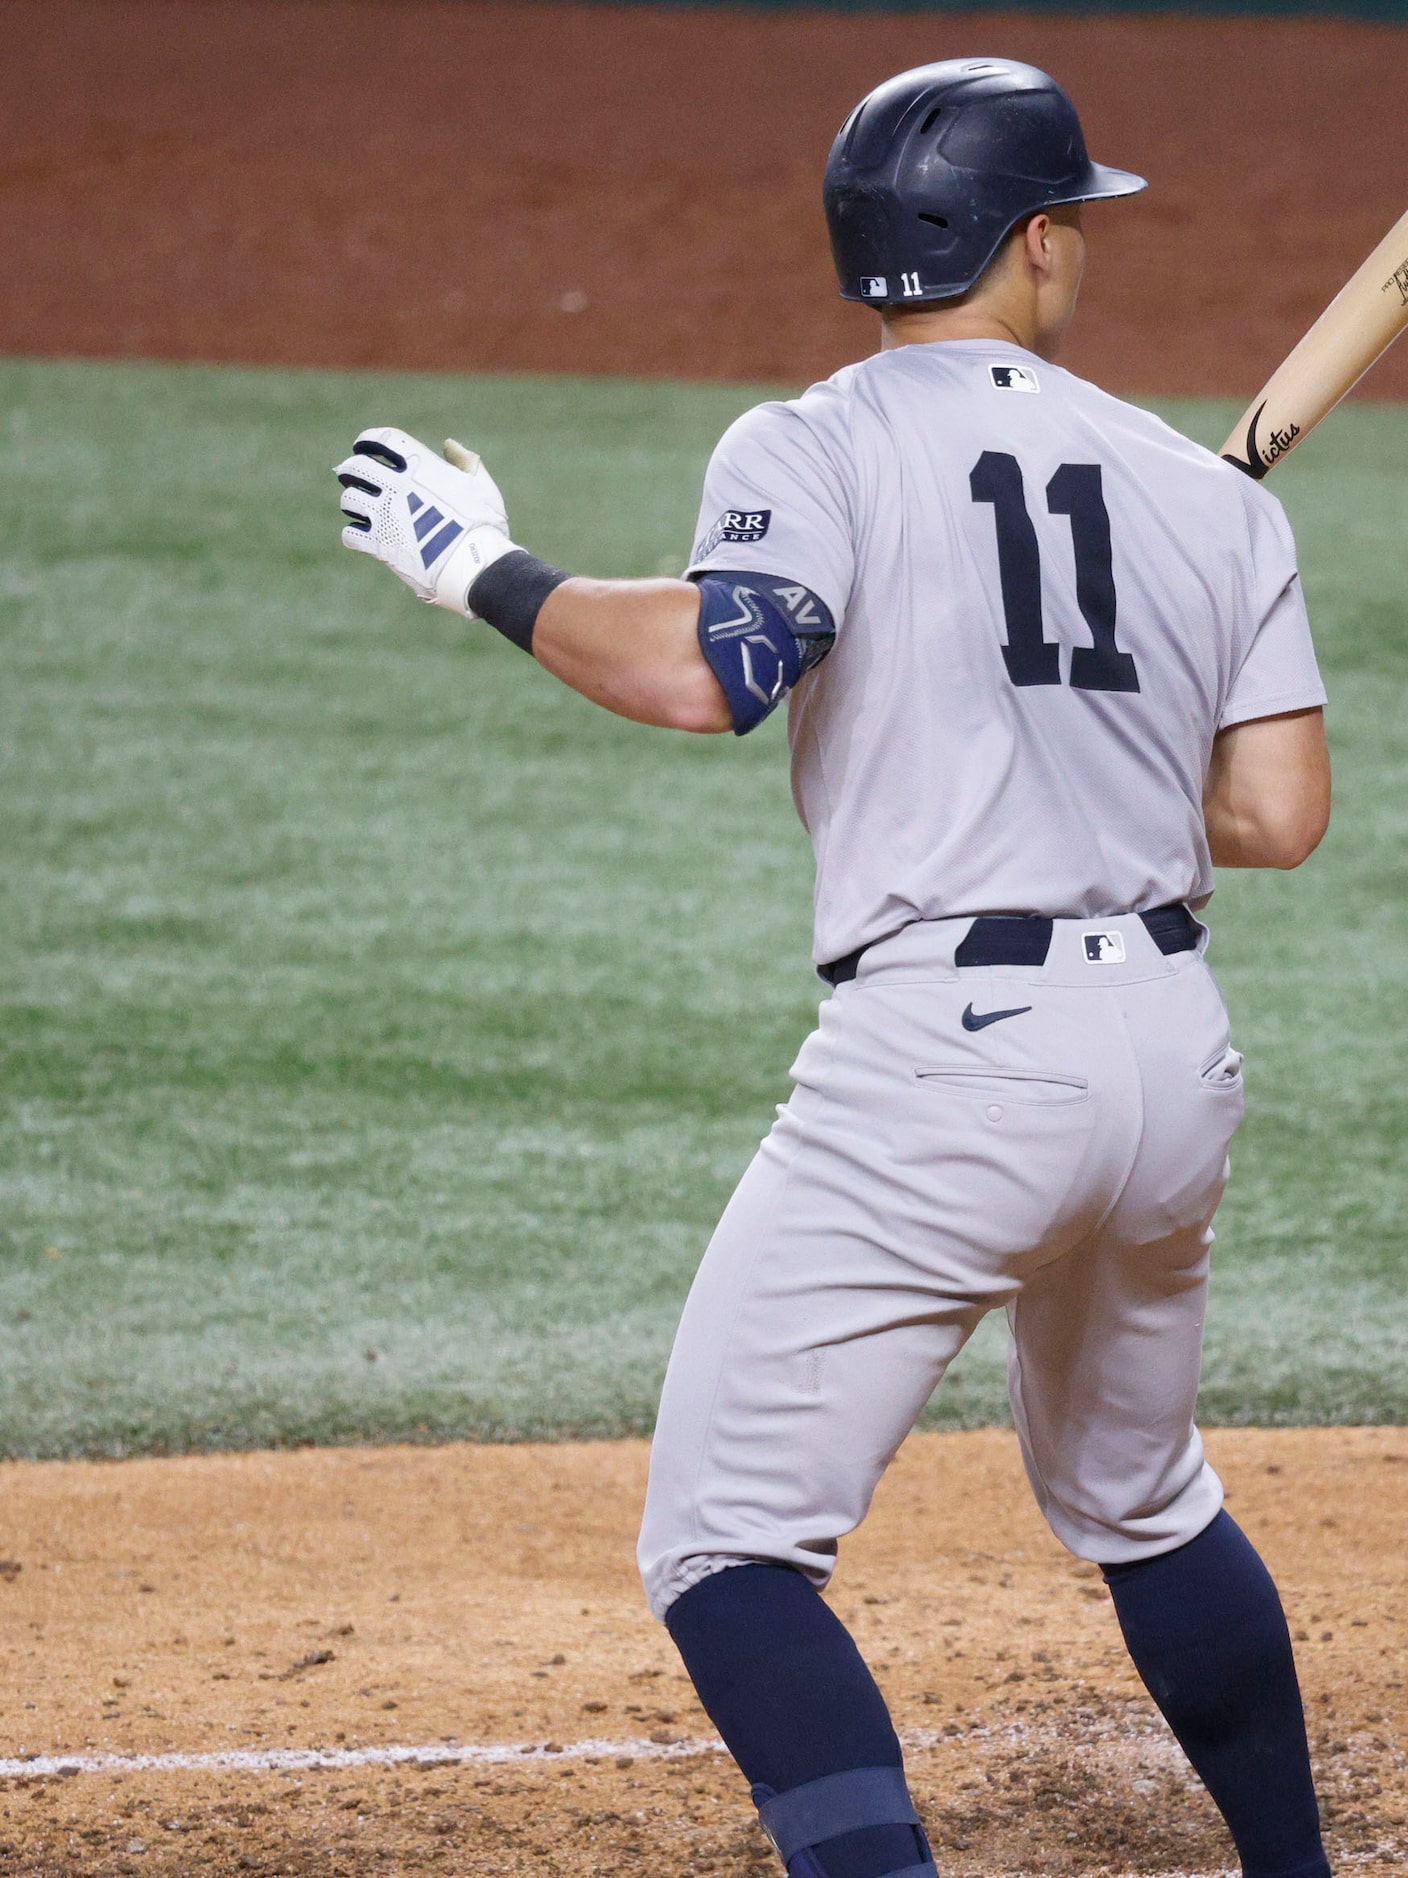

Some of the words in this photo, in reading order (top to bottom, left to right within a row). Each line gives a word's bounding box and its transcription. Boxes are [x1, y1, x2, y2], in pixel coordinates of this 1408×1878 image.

[900, 271, 923, 298] 11
[1221, 398, 1301, 480] Victus
[773, 586, 822, 626] AV
[969, 449, 1142, 704] 11
